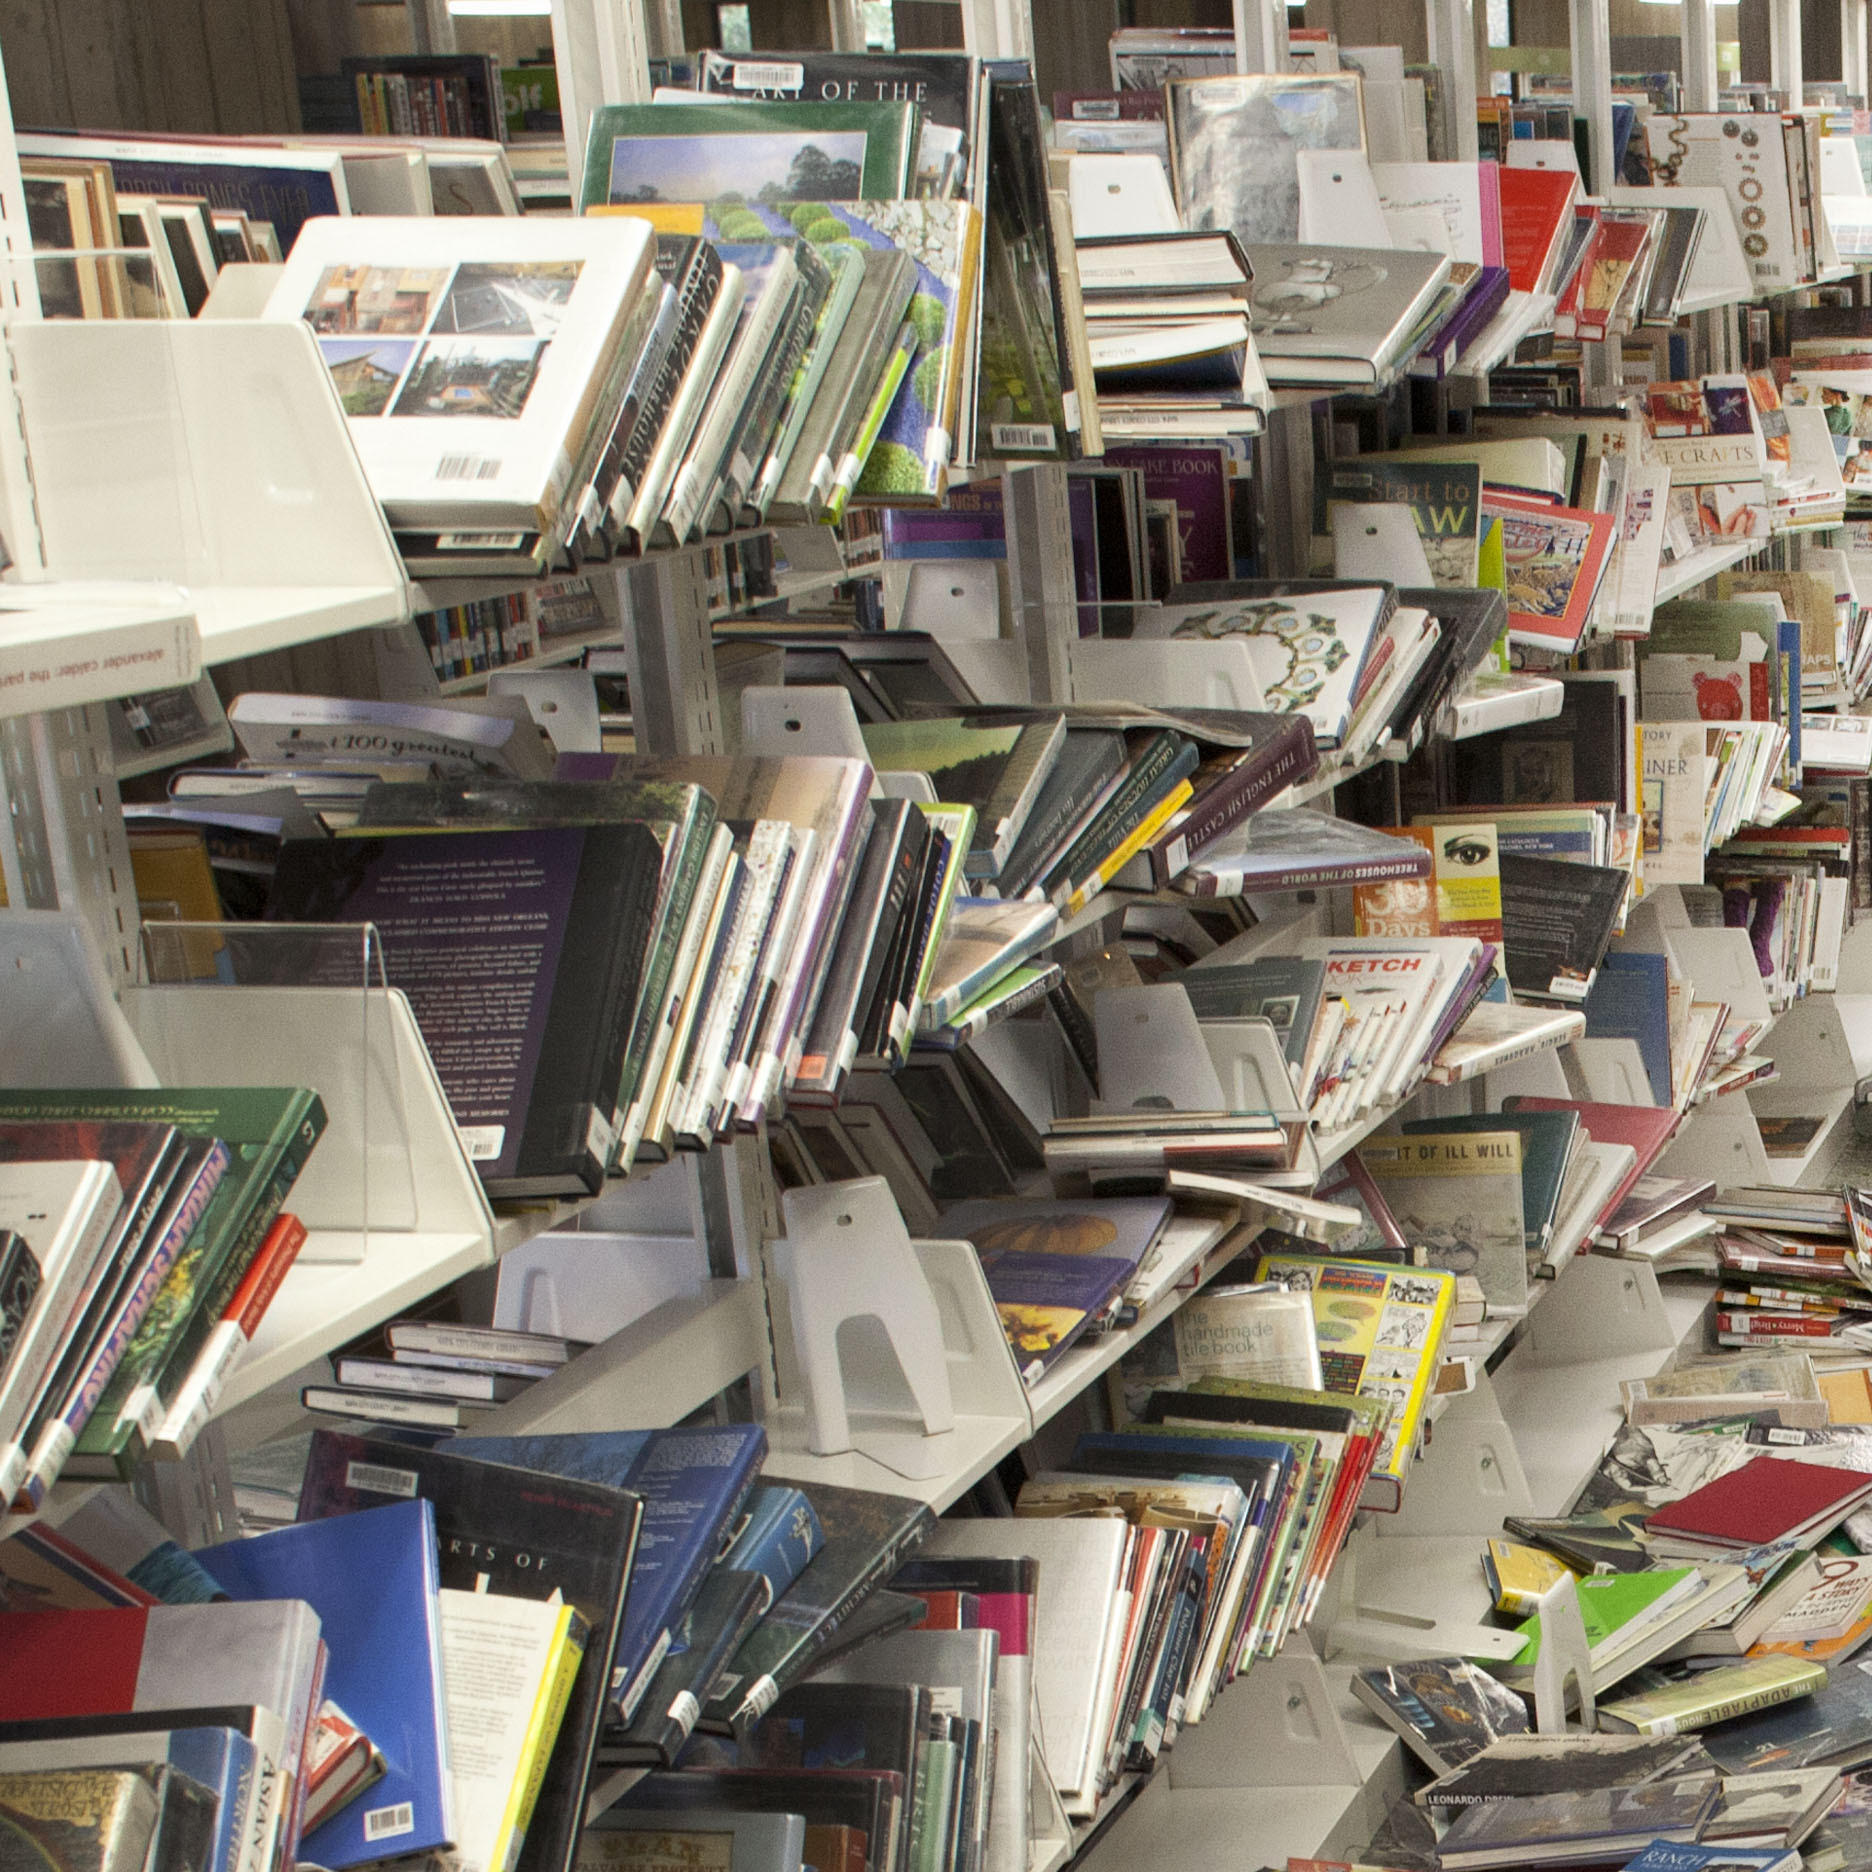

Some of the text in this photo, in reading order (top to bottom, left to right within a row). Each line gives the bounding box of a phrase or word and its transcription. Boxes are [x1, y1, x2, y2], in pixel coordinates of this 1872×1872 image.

[821, 81, 863, 102] OF
[873, 80, 929, 103] THE
[1679, 445, 1754, 464] CRAFTS
[1172, 457, 1217, 475] BOOK
[1367, 481, 1470, 499] Start to
[103, 648, 165, 672] alexander
[27, 665, 51, 684] the
[389, 736, 478, 764] greatest
[1274, 751, 1296, 776] THE
[1227, 770, 1276, 820] ENGLISH
[1281, 862, 1418, 884] TREEHOUSES OF THE WORLD
[1366, 919, 1430, 938] Days
[1325, 958, 1421, 974] KETCH
[1420, 1144, 1436, 1159] OF
[1446, 1143, 1469, 1158] ILL
[1475, 1142, 1513, 1158] WILL
[160, 1145, 233, 1257] MIRIAM
[1181, 1311, 1207, 1323] the
[1182, 1323, 1274, 1338] handmade
[1183, 1338, 1257, 1357] tile book
[438, 1540, 548, 1571] RTS OF
[1789, 1681, 1812, 1697] THE
[1703, 1686, 1792, 1724] ADAPTABLE
[255, 1753, 277, 1846] ASIAN
[1427, 1793, 1482, 1805] LEONARDO
[1642, 1850, 1706, 1865] RANCH
